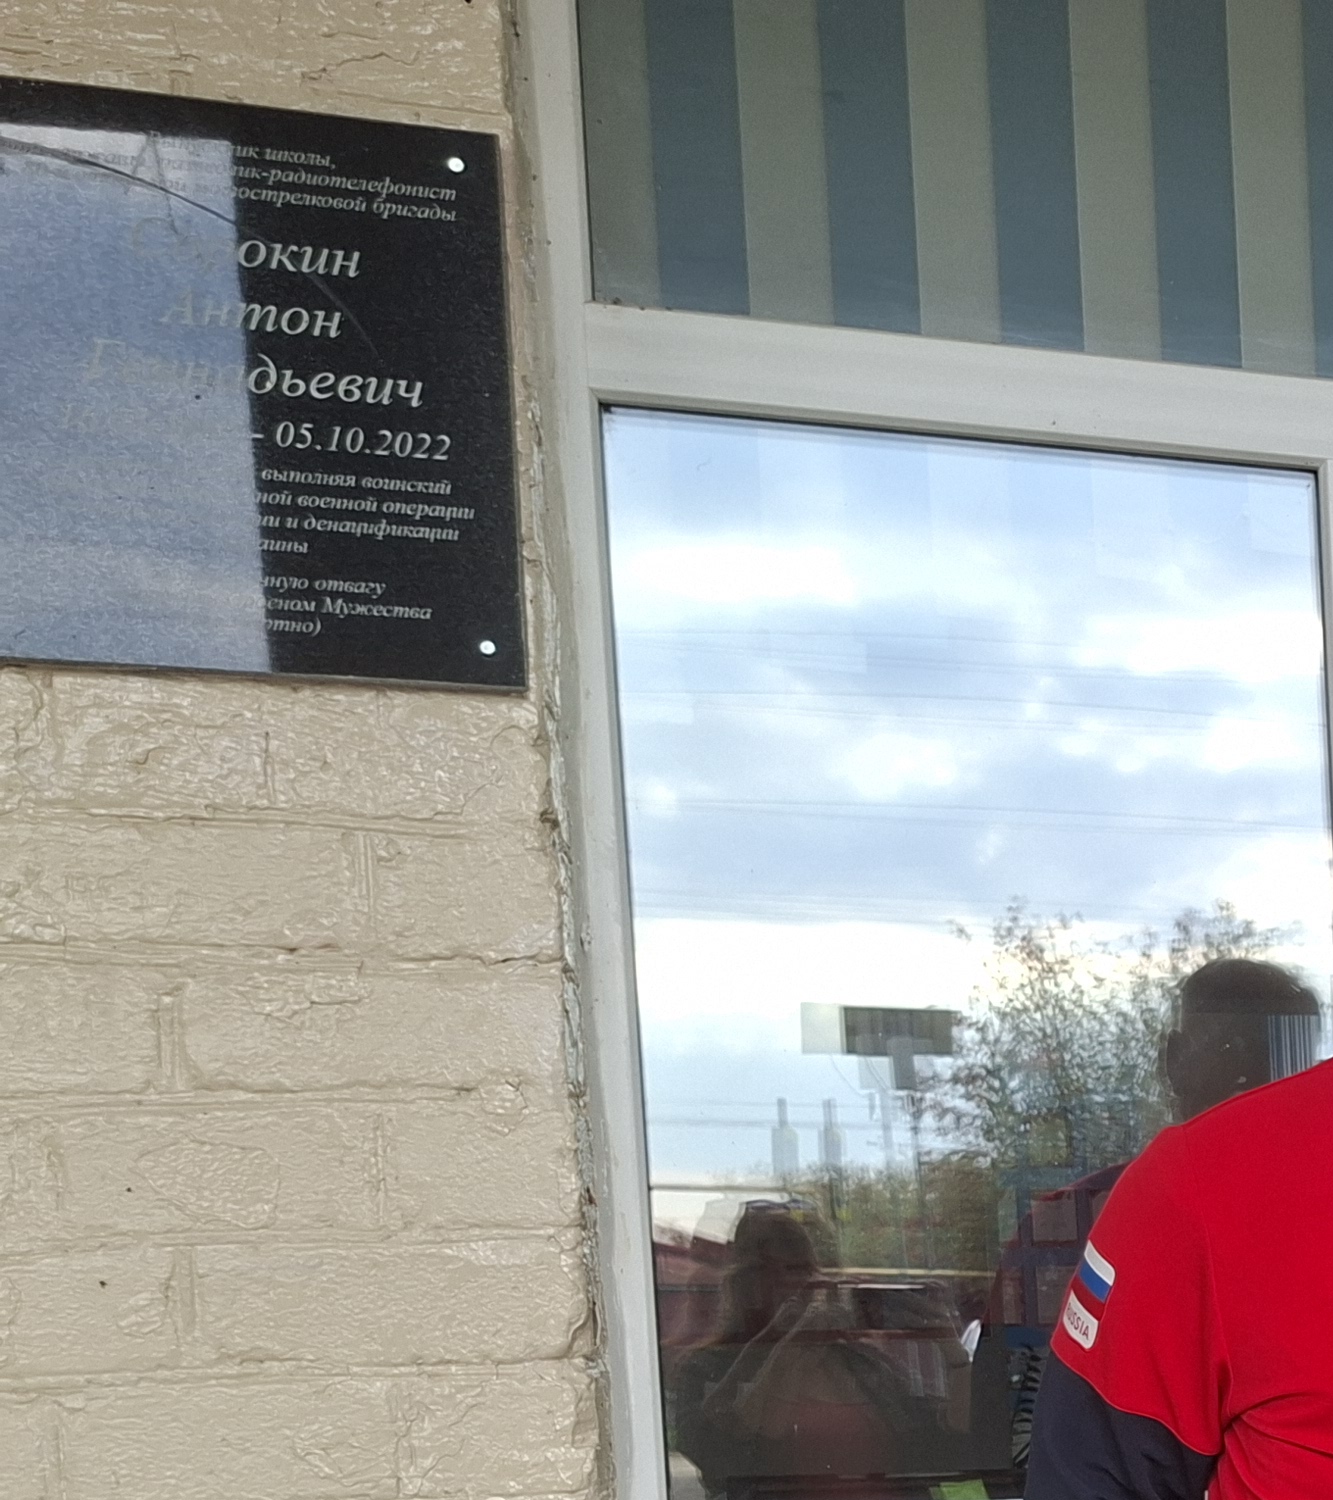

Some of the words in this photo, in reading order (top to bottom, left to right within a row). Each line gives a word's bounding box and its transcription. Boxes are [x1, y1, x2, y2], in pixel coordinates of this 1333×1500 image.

[264, 148, 336, 169] школы,
[372, 197, 457, 223] бригады
[275, 421, 452, 462] 05.10.2022
[261, 468, 356, 488] выполняя
[361, 475, 452, 495] воинский
[297, 493, 377, 513] военной
[382, 501, 475, 521] операции
[286, 517, 298, 529] и
[303, 514, 459, 542] денацификации
[313, 579, 386, 599] отвагу
[320, 596, 433, 621] Мужества
